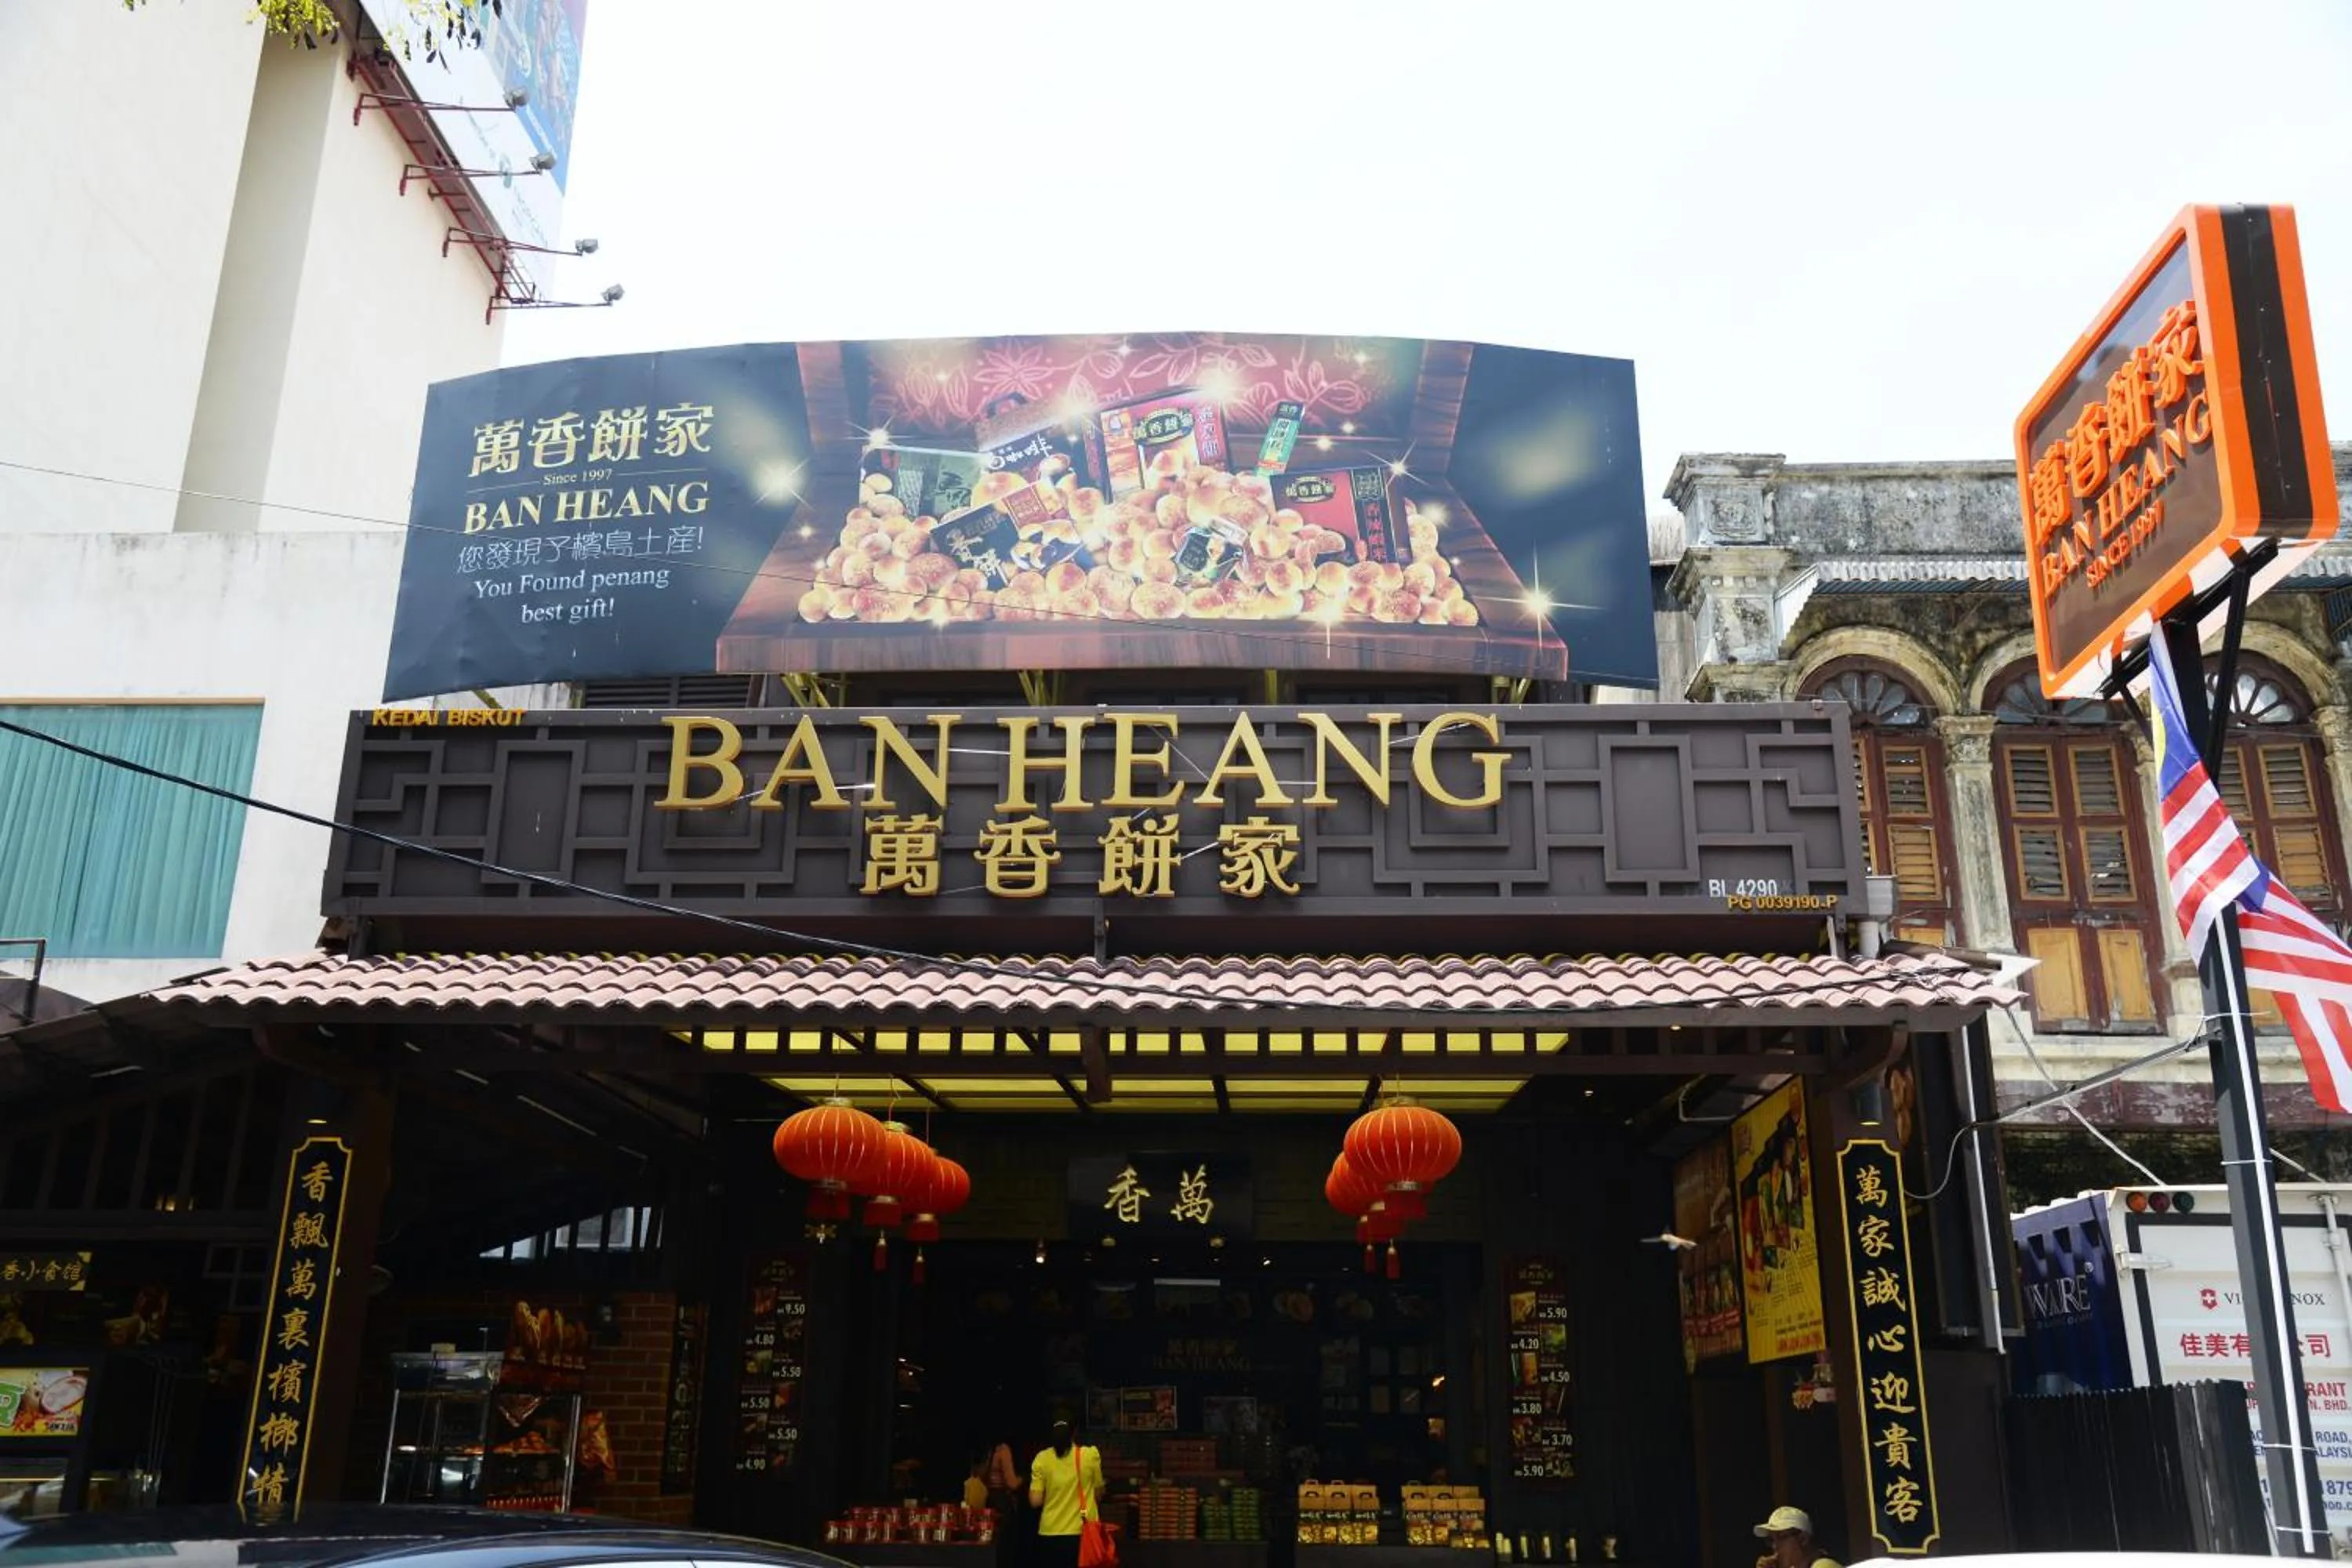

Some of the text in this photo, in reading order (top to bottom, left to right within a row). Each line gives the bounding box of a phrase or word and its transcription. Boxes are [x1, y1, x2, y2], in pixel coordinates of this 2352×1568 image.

[467, 402, 715, 477] 萬香餅家
[543, 469, 613, 486] Since 1997
[2041, 388, 2213, 599] BAN HEANG
[463, 481, 710, 535] BAN HEANG
[2085, 530, 2131, 589] SINCE
[474, 568, 672, 599] You Found penang
[521, 597, 615, 625] best gift!
[372, 708, 526, 728] KEDAI BISKUT
[654, 710, 1512, 812] BAN HEANG
[859, 812, 1301, 898] 萬香餅家
[1736, 879, 1778, 898] 4290
[1728, 895, 1752, 910] PG
[1546, 1307, 1568, 1318] 5.90
[1519, 1338, 1539, 1349] 4.20
[1855, 1167, 1924, 1524] 萬家誠心迎貴客
[781, 1366, 801, 1377] 5.50
[1550, 1371, 1570, 1383] 4.50
[777, 1428, 797, 1439] 5.50
[1552, 1434, 1573, 1446] 3.70
[1523, 1465, 1544, 1477] 5.90
